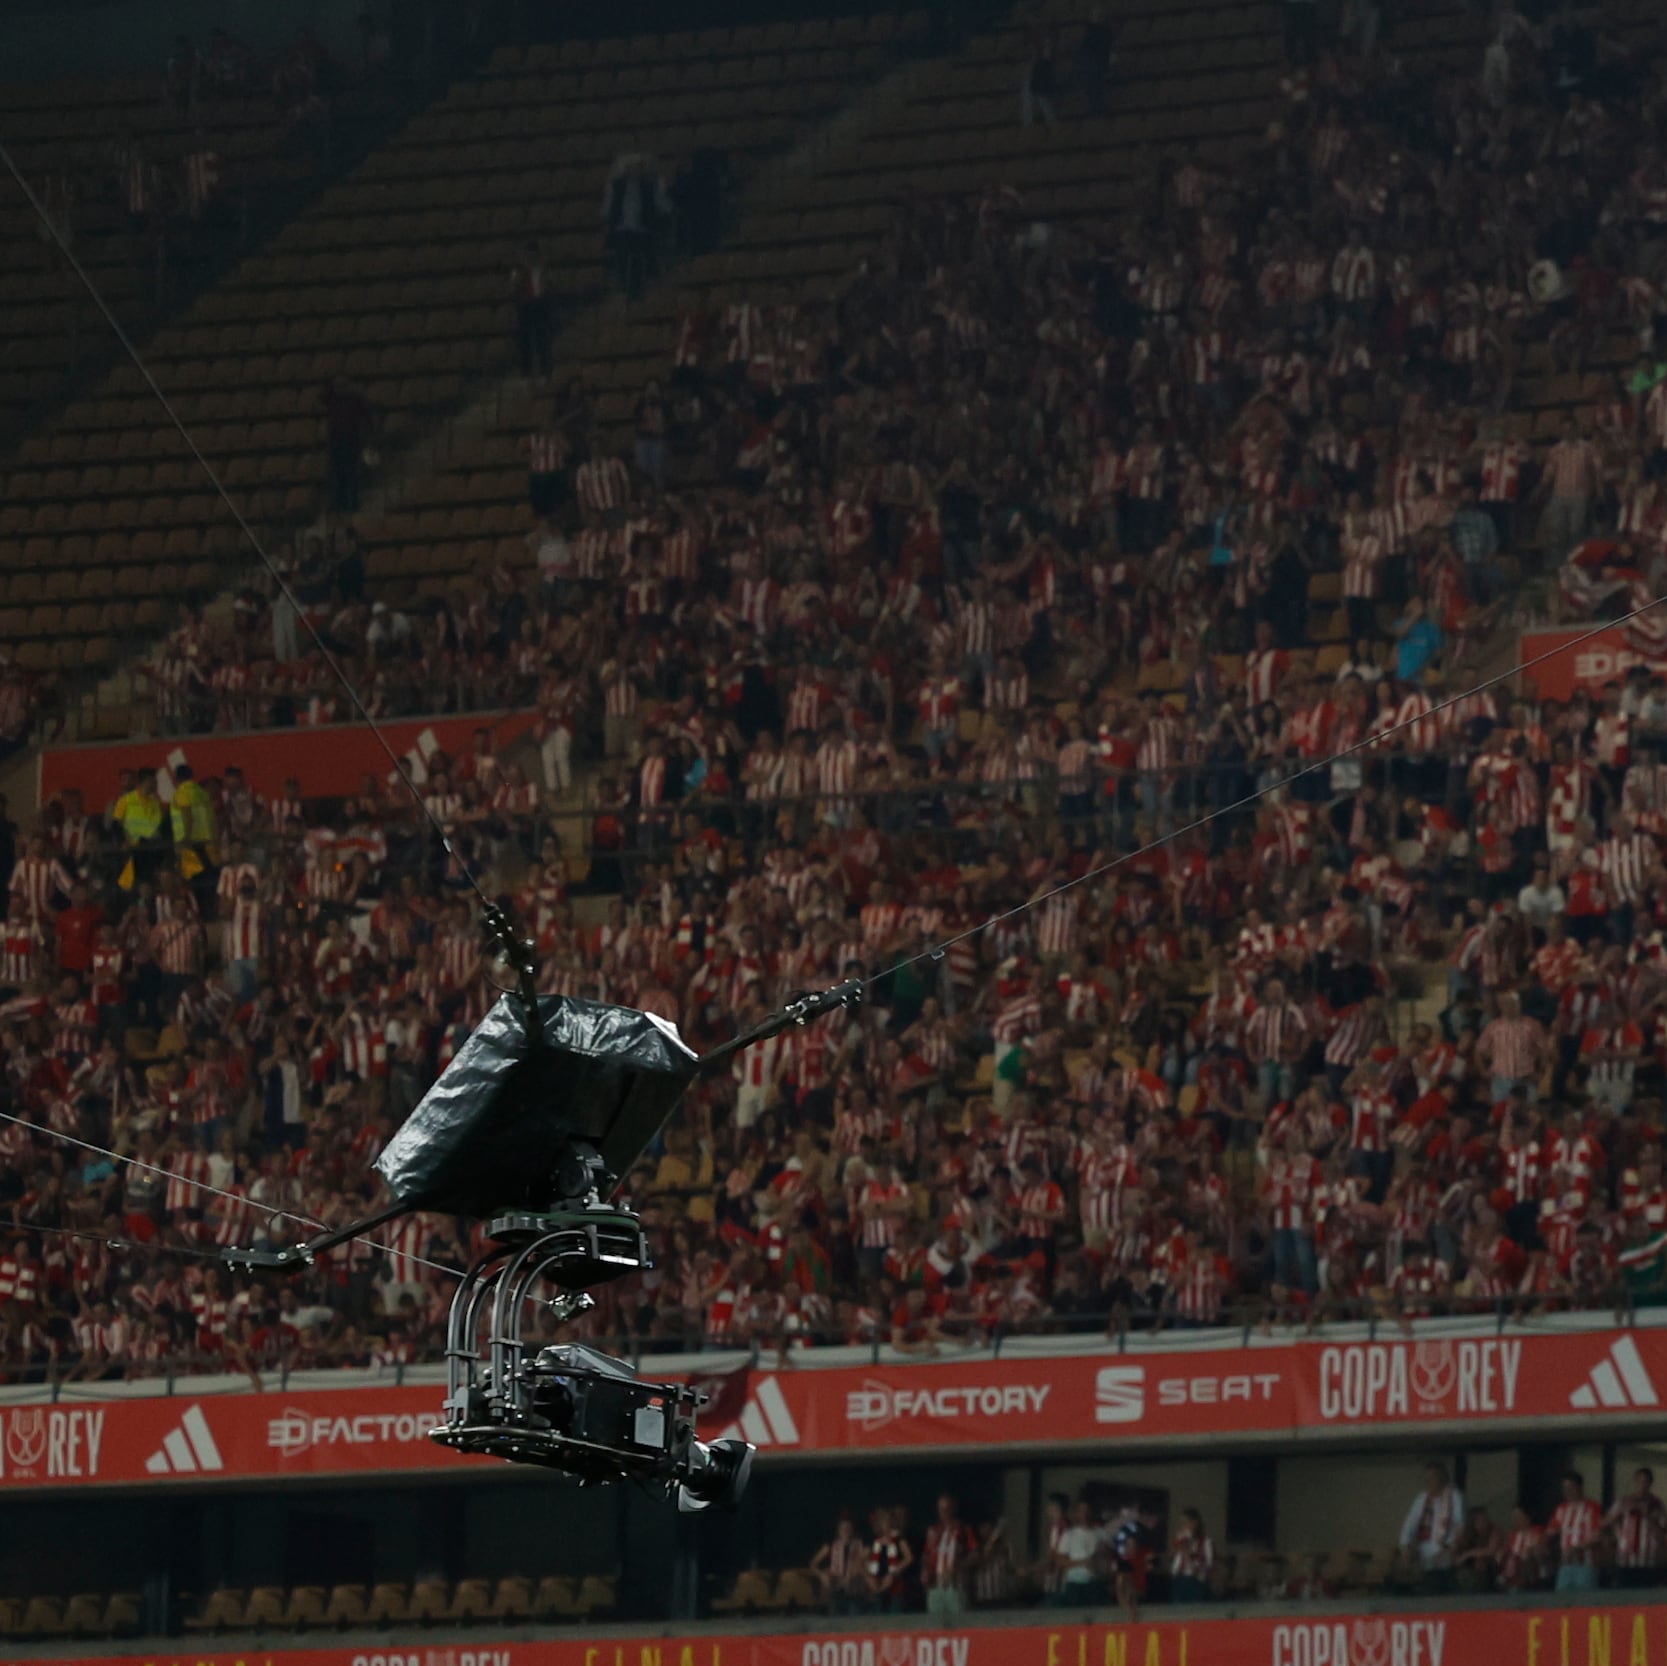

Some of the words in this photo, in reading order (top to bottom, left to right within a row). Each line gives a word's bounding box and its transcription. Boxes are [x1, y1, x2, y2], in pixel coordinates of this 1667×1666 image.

[1158, 1374, 1281, 1405] SEAT
[1319, 1342, 1408, 1418] COPA
[1457, 1339, 1522, 1413] REY
[893, 1383, 1051, 1418] FACTORY
[47, 1409, 105, 1476] REY
[312, 1412, 446, 1446] FACTOR
